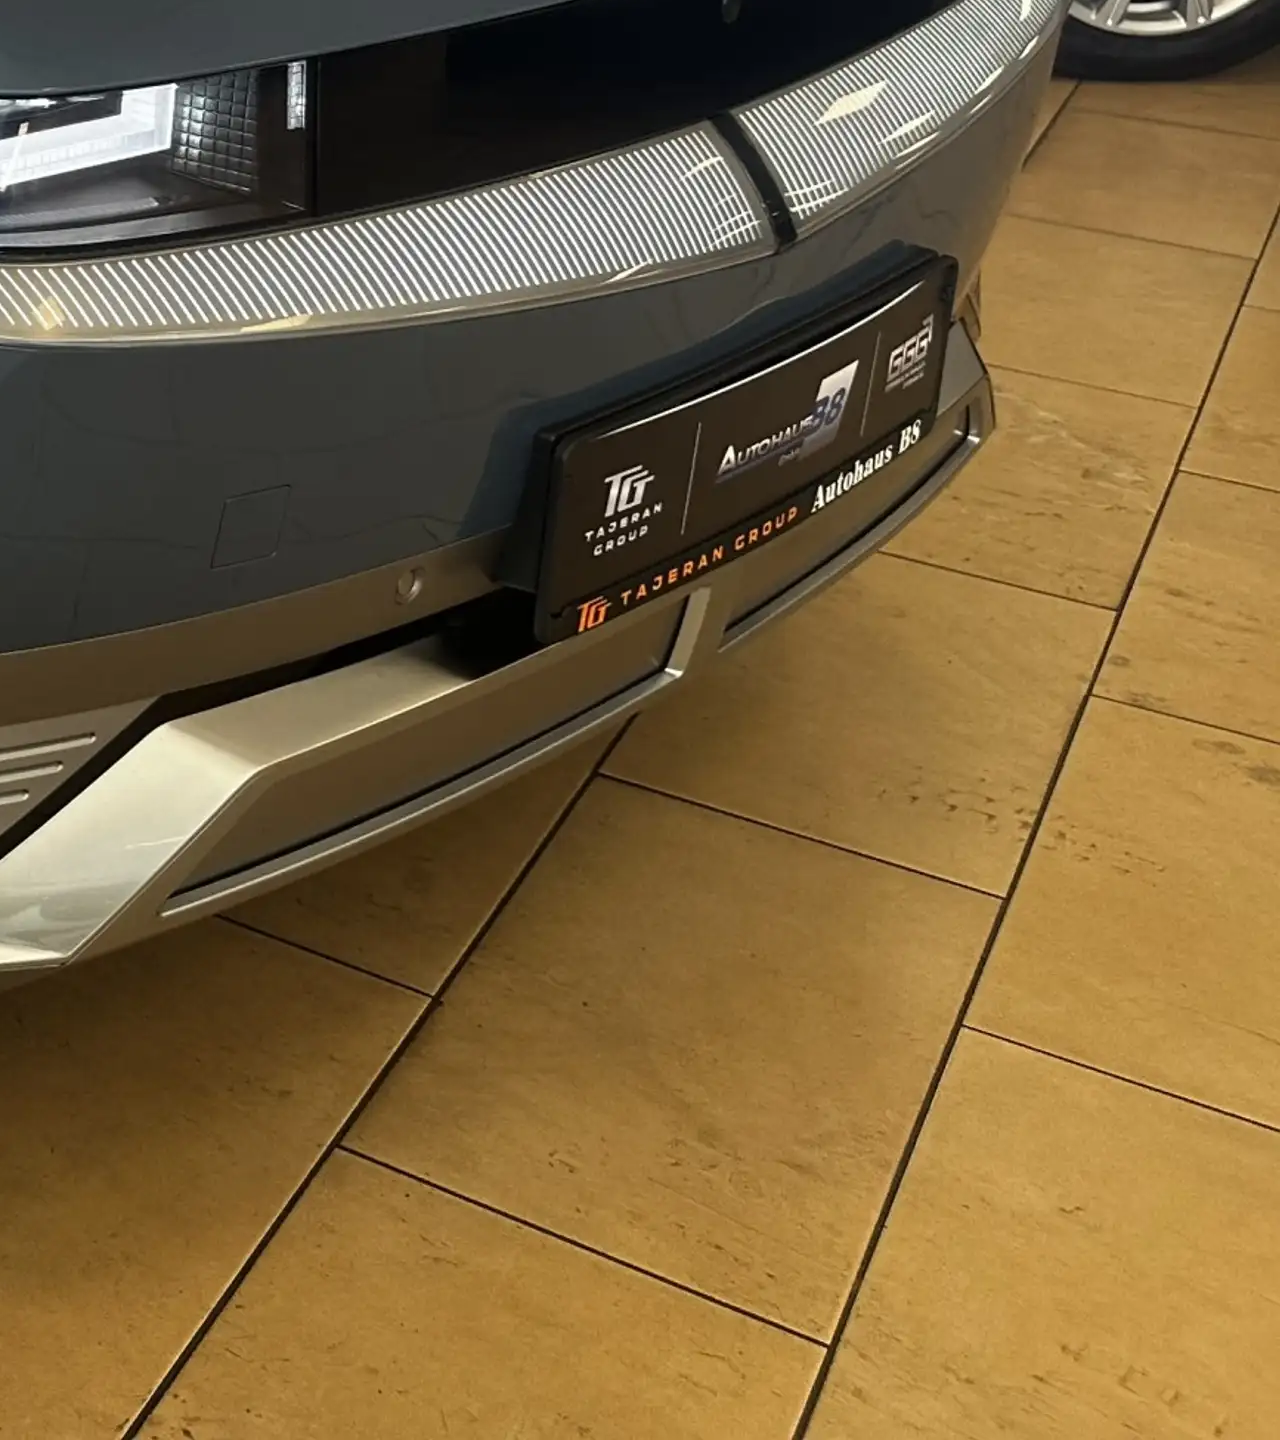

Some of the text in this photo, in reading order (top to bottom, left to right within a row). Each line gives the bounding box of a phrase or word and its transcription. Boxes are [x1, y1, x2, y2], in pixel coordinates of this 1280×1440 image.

[584, 502, 663, 542] TAJERAN
[593, 524, 649, 556] GROUP
[620, 545, 724, 607] TAJERAN
[734, 506, 799, 551] GROUP
[811, 444, 893, 513] Autohaus
